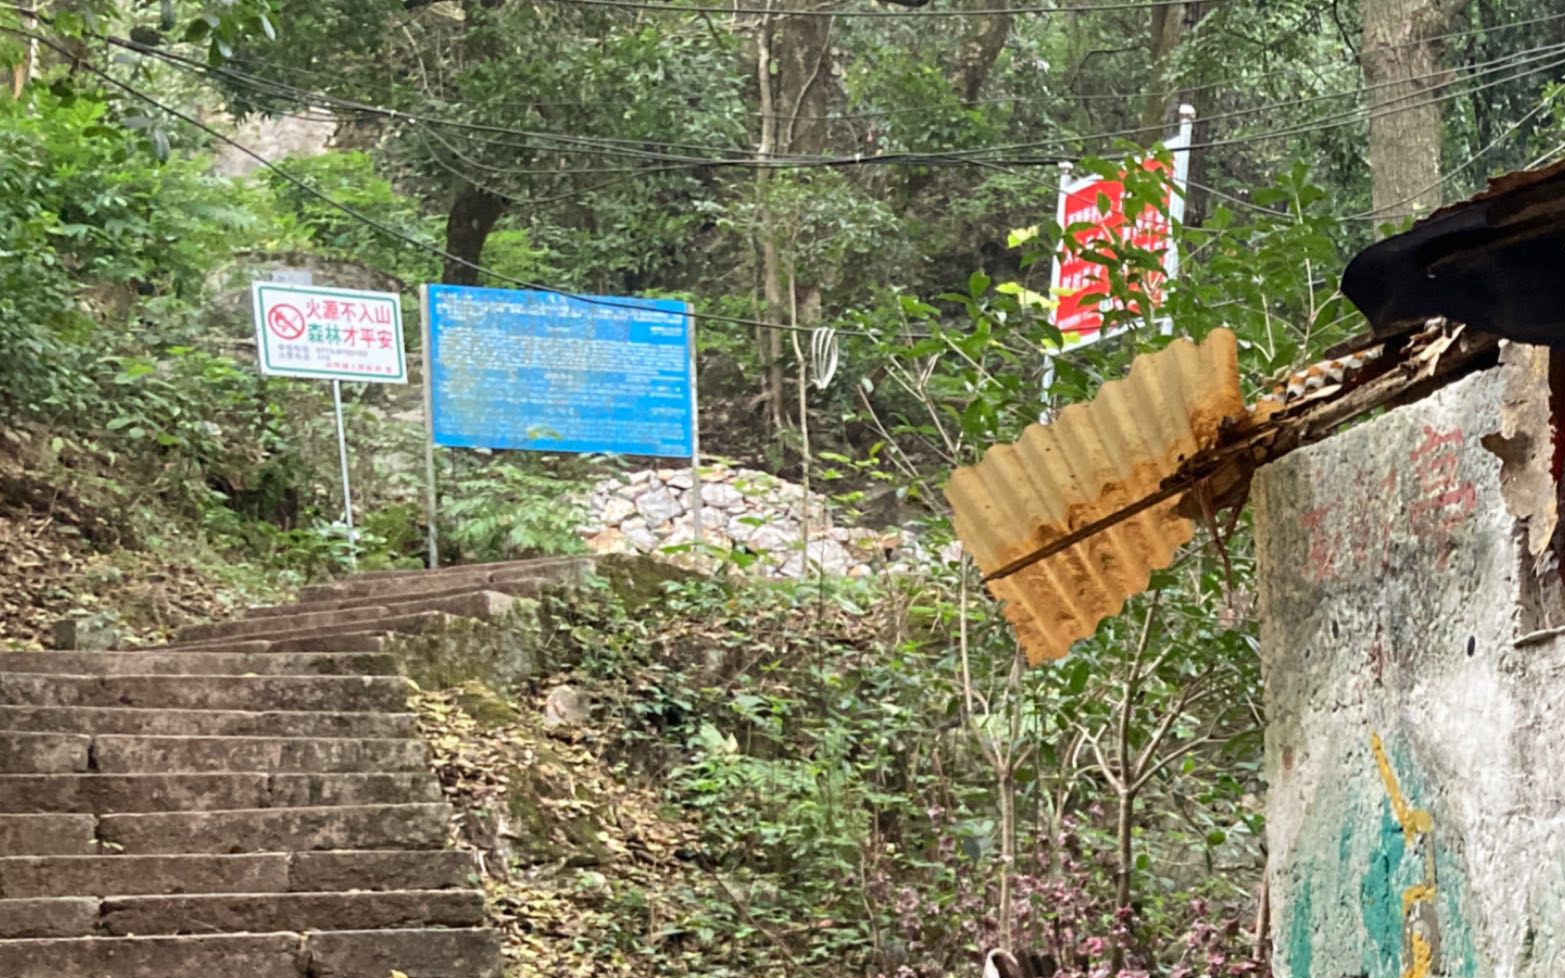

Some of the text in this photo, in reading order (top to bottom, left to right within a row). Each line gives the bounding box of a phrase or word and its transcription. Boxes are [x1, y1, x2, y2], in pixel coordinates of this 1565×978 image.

[307, 298, 390, 324] 火源不入山
[308, 323, 393, 349] 森林才平安
